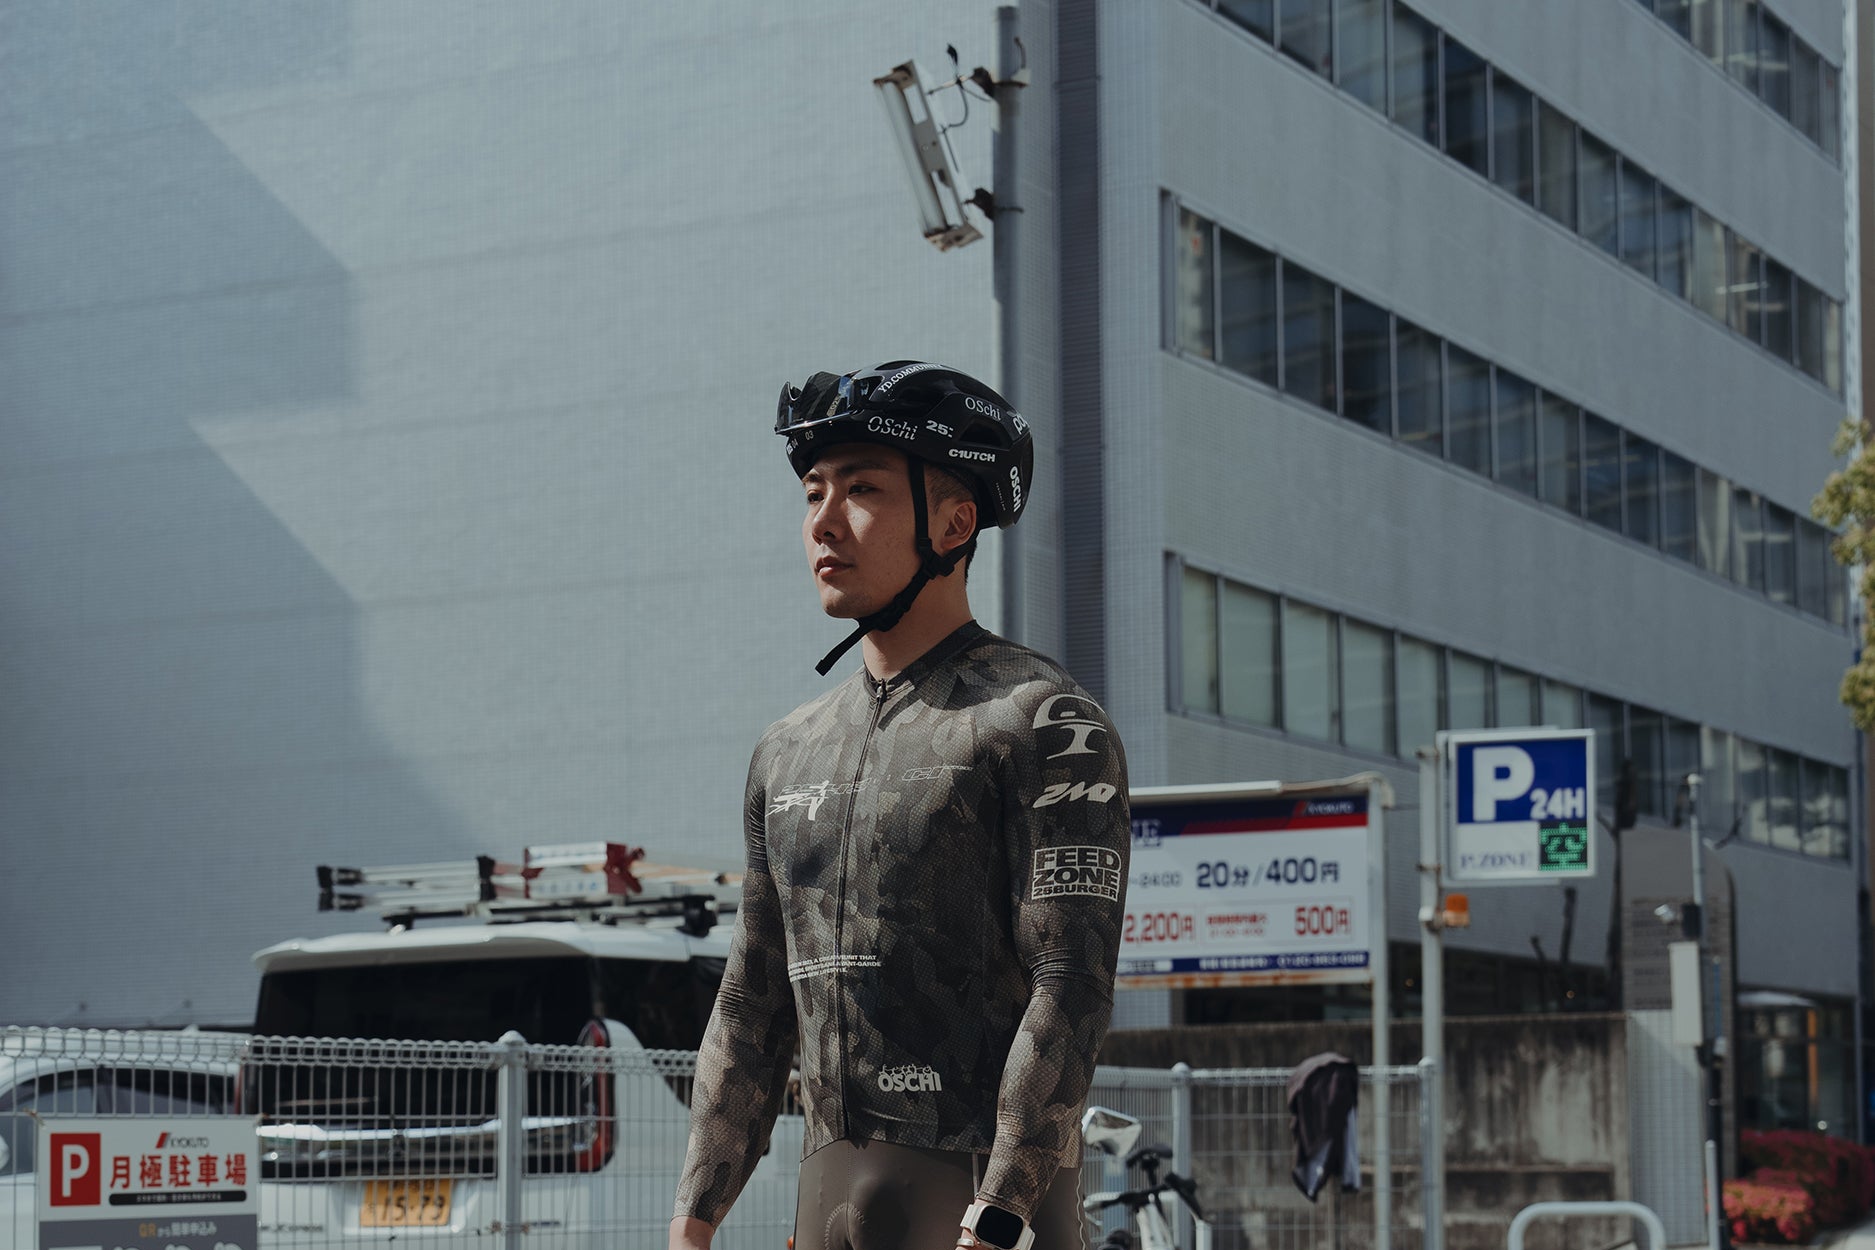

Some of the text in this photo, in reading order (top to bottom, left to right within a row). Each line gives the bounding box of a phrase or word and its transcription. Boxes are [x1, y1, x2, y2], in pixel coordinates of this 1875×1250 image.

[964, 397, 1002, 421] OSchi
[867, 415, 919, 441] OSchi
[1009, 466, 1022, 512] OSCHI
[1472, 745, 1535, 822] P
[1529, 787, 1586, 820] 24H
[1035, 847, 1121, 872] FEED
[1032, 866, 1121, 889] ZONE
[1032, 883, 1119, 900] 25BURGER
[1295, 905, 1350, 937] 500円
[878, 1070, 942, 1092] OSCHI
[62, 1143, 91, 1198] P
[109, 1152, 247, 1189] 月極駐車場
